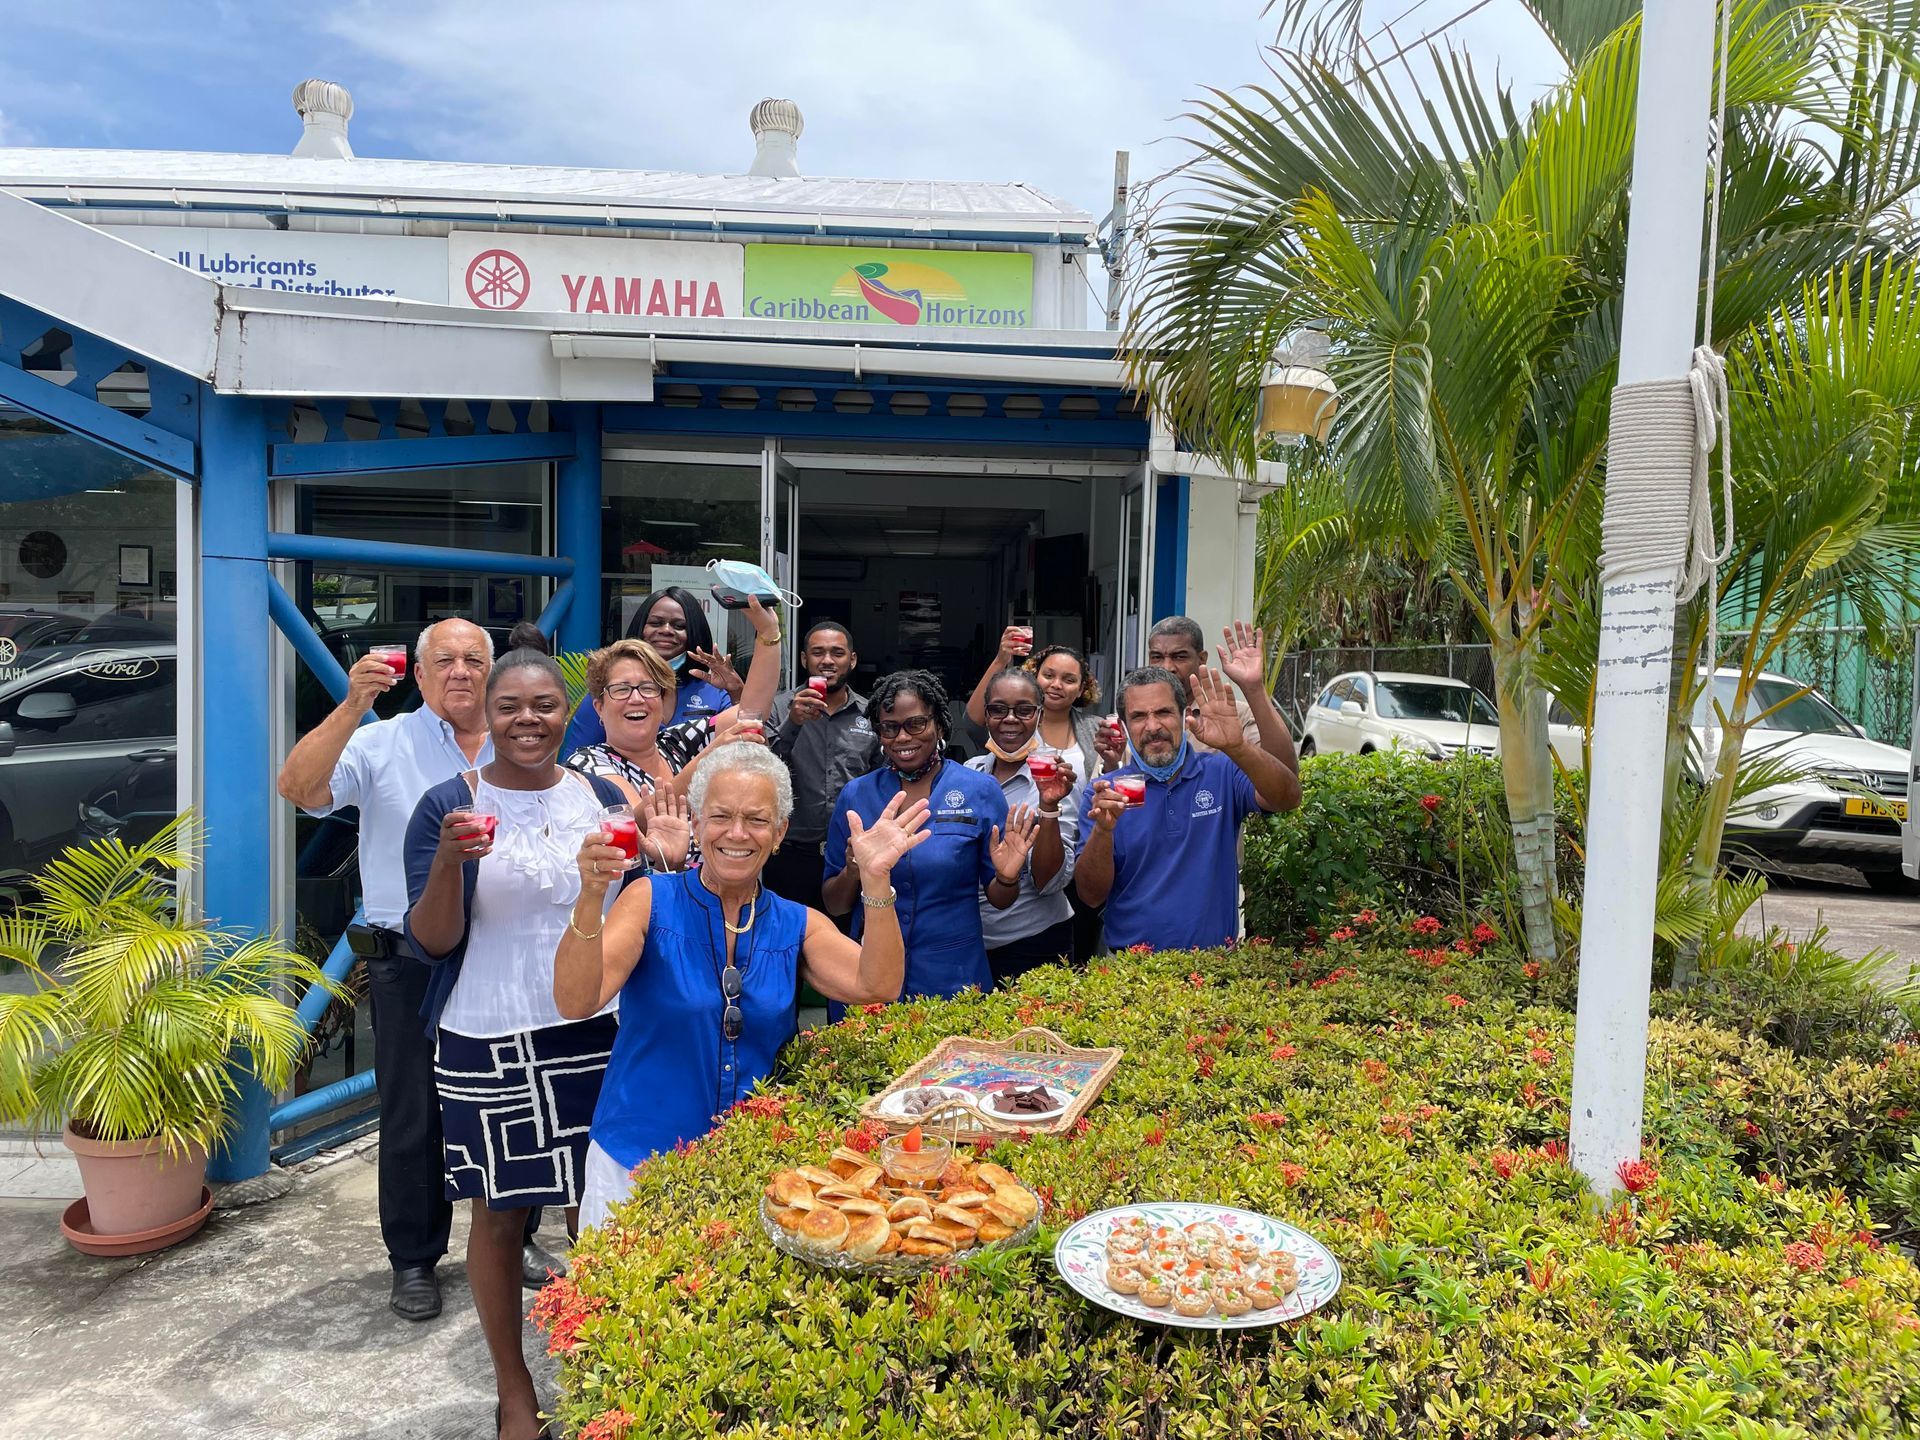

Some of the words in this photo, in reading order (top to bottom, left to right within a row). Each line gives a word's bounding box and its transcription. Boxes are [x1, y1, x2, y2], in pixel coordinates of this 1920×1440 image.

[199, 252, 317, 276] Lubricants
[560, 274, 725, 317] YAMAHA
[749, 296, 869, 321] Caribbean
[926, 302, 1026, 326] Horizons
[88, 651, 143, 676] Ford
